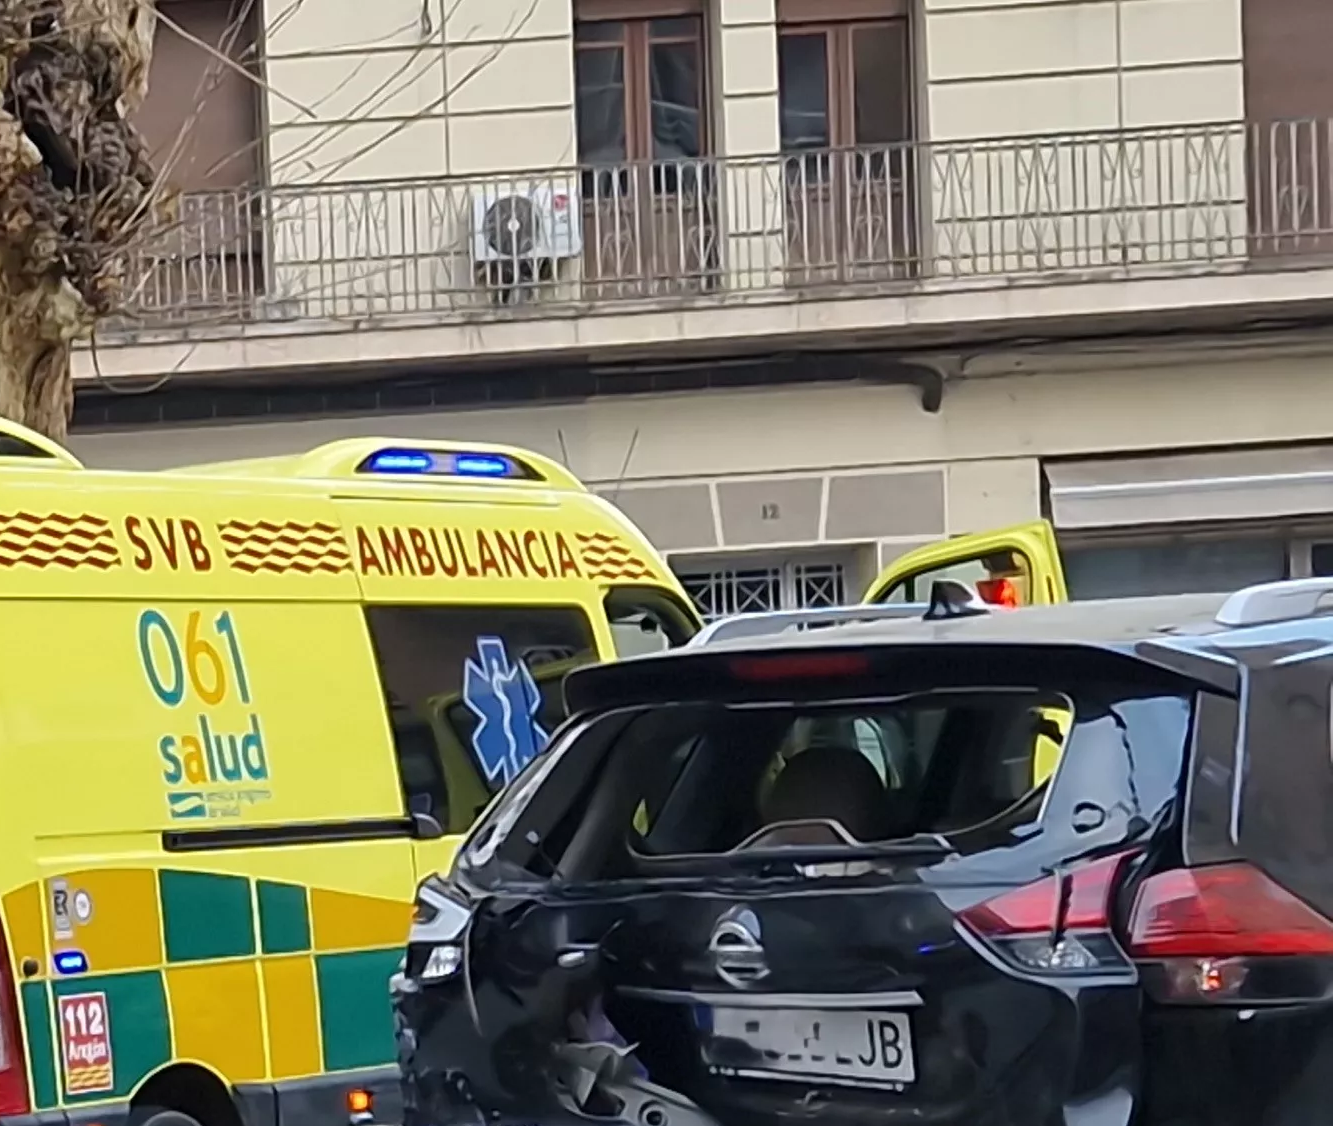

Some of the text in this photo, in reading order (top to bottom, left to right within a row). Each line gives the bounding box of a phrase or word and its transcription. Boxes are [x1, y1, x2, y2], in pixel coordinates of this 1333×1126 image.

[124, 515, 212, 572] SVB
[356, 525, 582, 578] AMBULANCIA
[139, 610, 251, 707] 061
[160, 713, 269, 784] salud
[64, 1001, 105, 1037] 112
